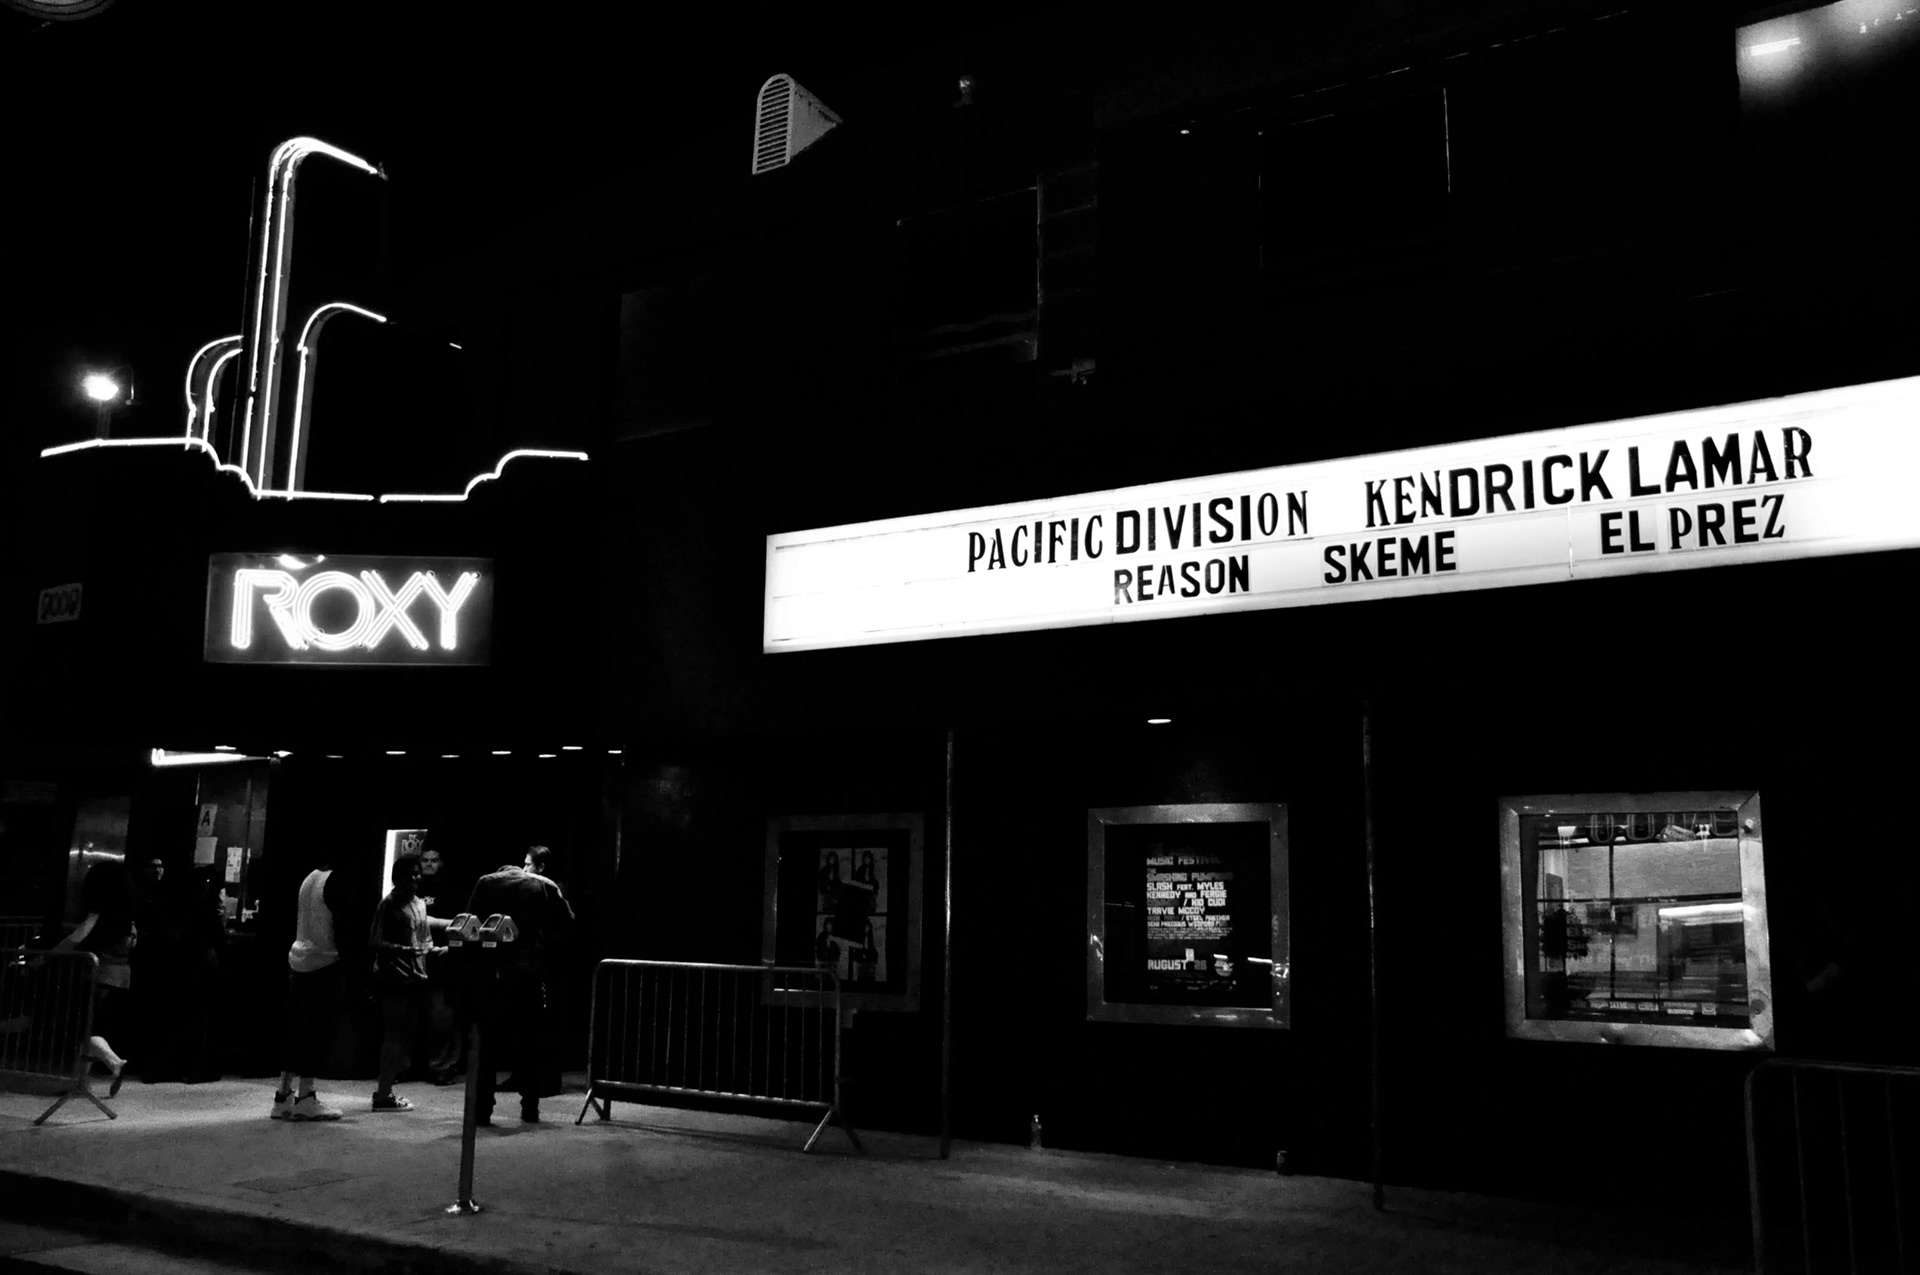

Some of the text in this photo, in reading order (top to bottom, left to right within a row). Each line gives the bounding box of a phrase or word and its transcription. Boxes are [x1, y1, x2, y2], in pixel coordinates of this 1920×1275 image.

[968, 426, 1814, 573] PACIFIC DIVISION KENDRICK LAMAR
[1113, 494, 1786, 605] REASON SKEME EL PREZ
[230, 568, 482, 650] ROXY
[200, 808, 211, 827] A
[1146, 856, 1174, 866] MUSIC
[1146, 881, 1173, 891] SLASH
[1196, 881, 1225, 891] MYLES
[1146, 889, 1182, 899] KENNEDY
[1200, 889, 1228, 899] FERGIE
[1190, 898, 1205, 907] KID
[1146, 906, 1175, 915] TRAVIE
[1147, 959, 1188, 971] AUGUST
